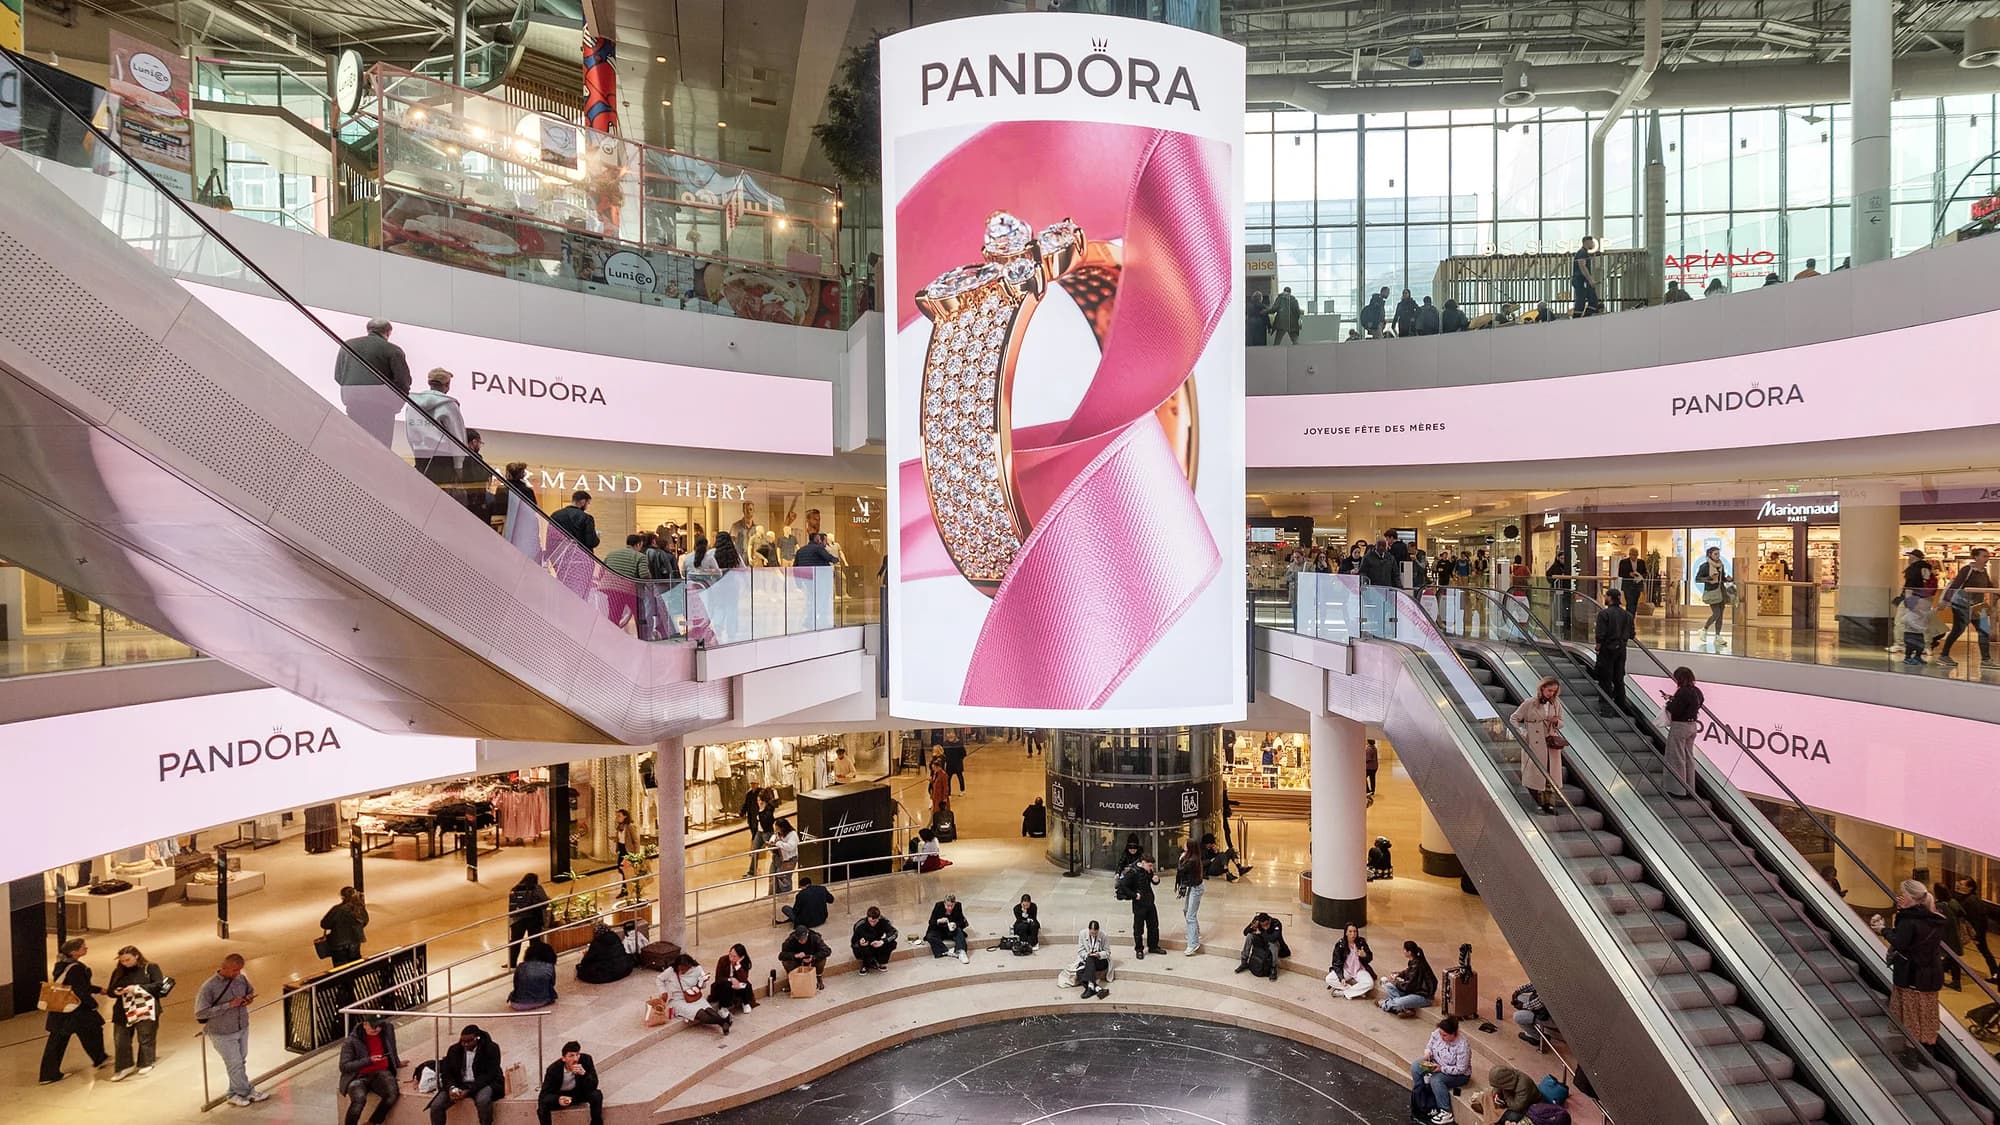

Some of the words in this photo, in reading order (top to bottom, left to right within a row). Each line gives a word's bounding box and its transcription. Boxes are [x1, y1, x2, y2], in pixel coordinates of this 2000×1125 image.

[922, 37, 1200, 111] PANDORA
[471, 370, 607, 406] PANDORA
[1672, 380, 1805, 416] PANDORA
[1303, 426, 1351, 436] JOYEUSE
[1354, 424, 1381, 434] FÊTE
[1384, 424, 1406, 433] DES
[1409, 421, 1446, 432] MÈRES
[658, 478, 747, 500] THIERY
[1757, 500, 1839, 521] Marionnaud
[159, 723, 342, 782] PANDORA
[1099, 801, 1115, 809] PLACE
[828, 809, 874, 843] Harcourt
